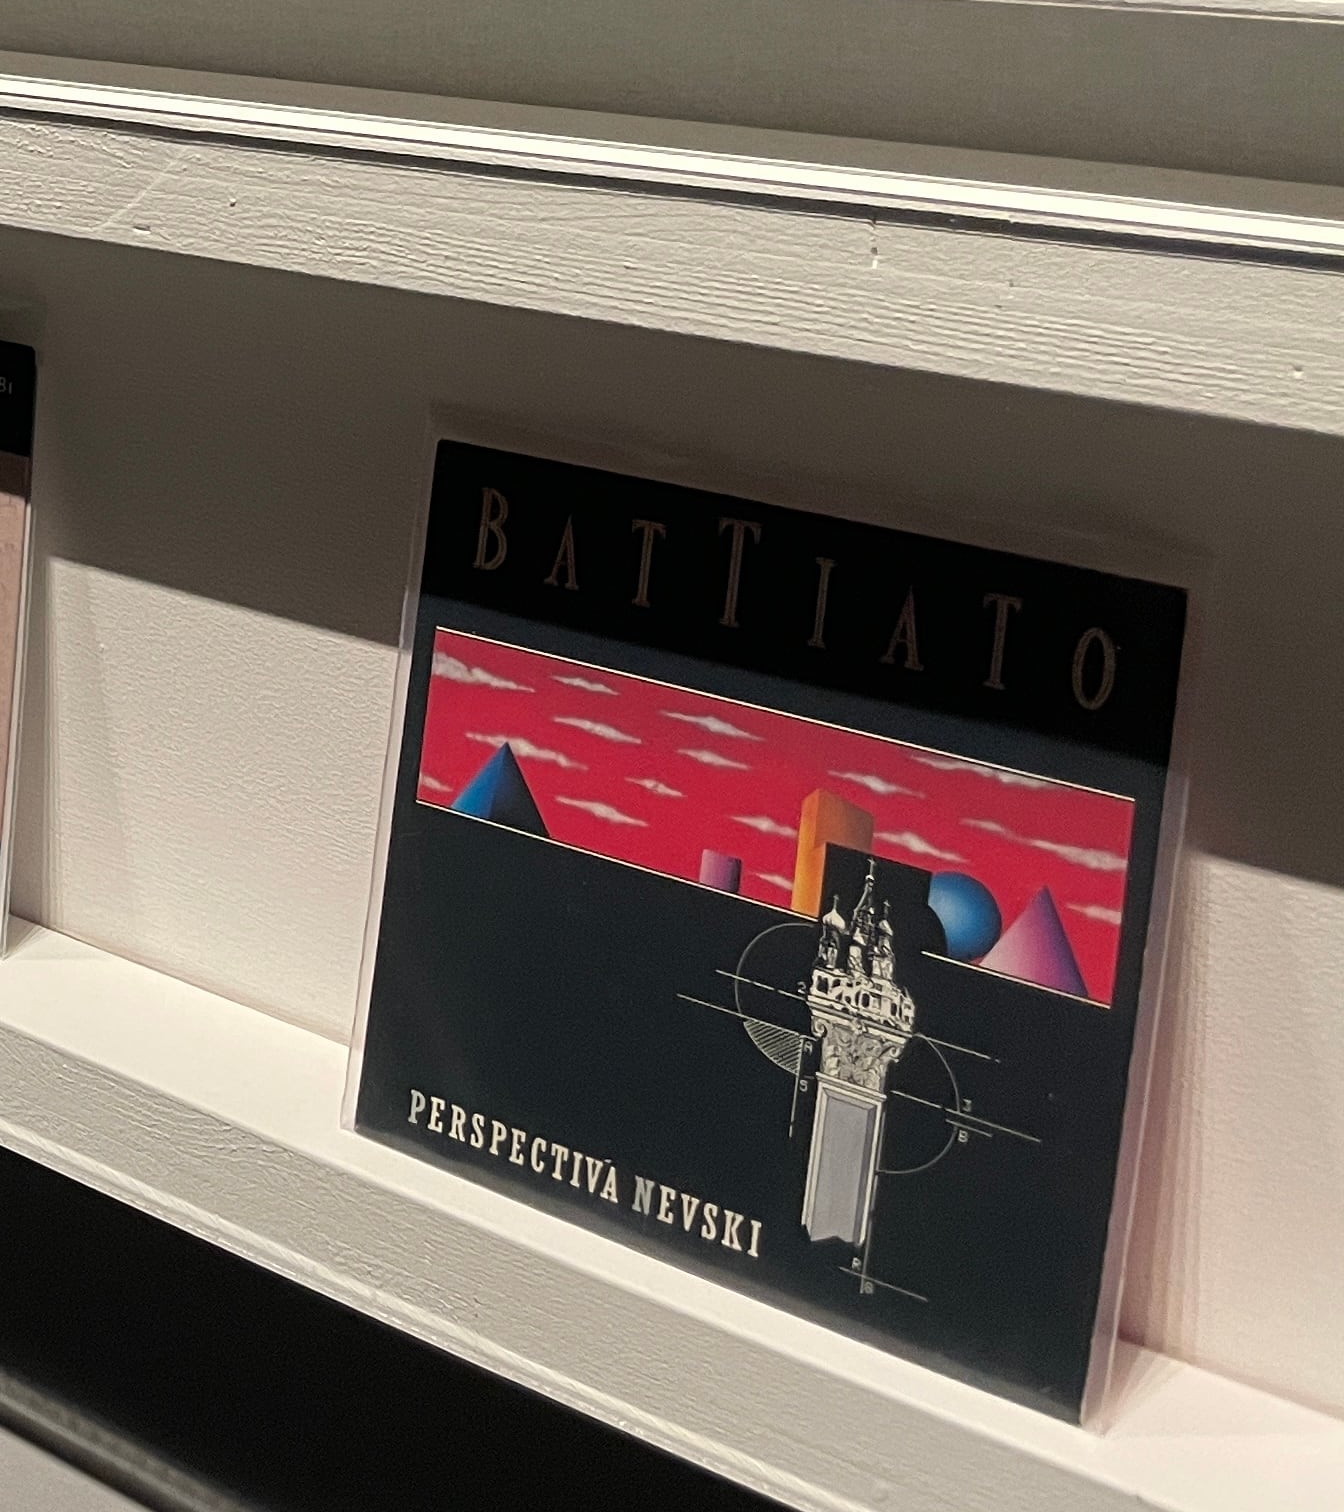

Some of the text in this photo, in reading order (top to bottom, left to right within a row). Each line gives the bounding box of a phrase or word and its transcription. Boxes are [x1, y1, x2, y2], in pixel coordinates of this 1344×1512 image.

[470, 486, 1117, 713] BATTIATO
[405, 1088, 765, 1259] PERSPECTIVA NEVSKI
